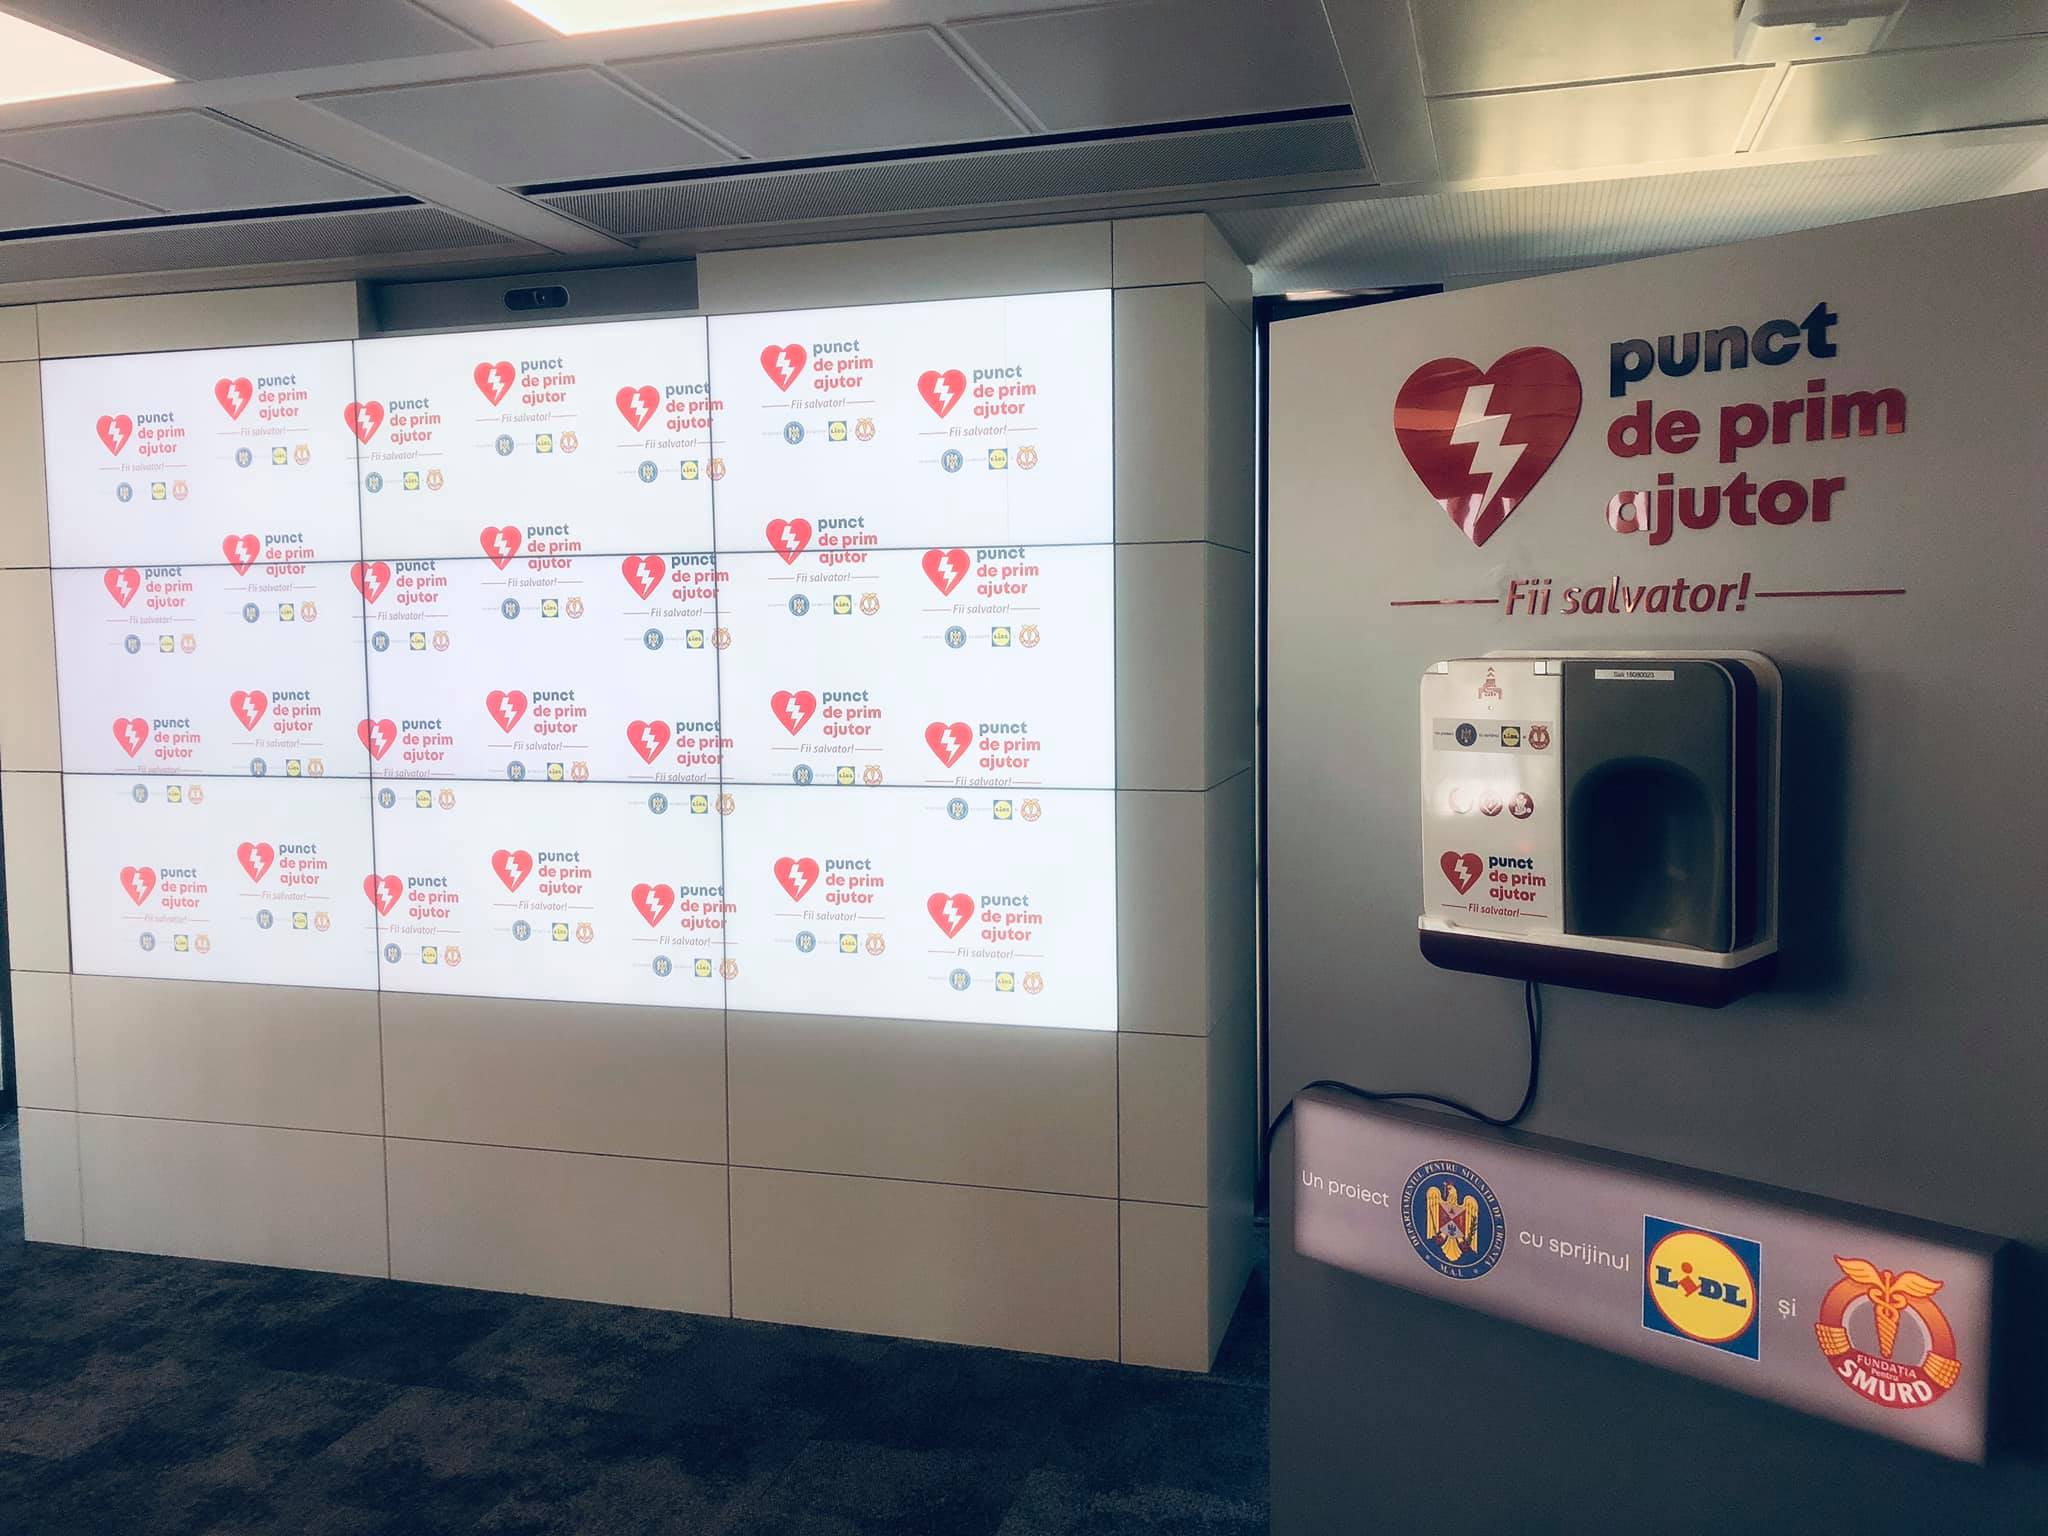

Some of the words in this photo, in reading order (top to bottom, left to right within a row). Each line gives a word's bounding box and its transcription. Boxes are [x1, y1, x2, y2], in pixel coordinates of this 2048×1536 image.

[813, 339, 860, 357] punct
[1610, 302, 1838, 397] punct
[520, 357, 564, 373] punct
[813, 358, 833, 371] de
[837, 356, 873, 373] prim
[257, 374, 297, 389] punct
[521, 374, 539, 387] de
[542, 372, 575, 389] prim
[973, 365, 1023, 383] punct
[665, 382, 711, 398] punct
[813, 374, 862, 391] ajutor
[258, 390, 274, 402] de
[277, 388, 307, 404] prim
[521, 390, 566, 405] ajutor
[973, 384, 994, 398] de
[998, 382, 1036, 400] prim
[258, 405, 299, 420] ajutor
[389, 397, 430, 413] punct
[666, 399, 685, 412] de
[688, 398, 723, 414] prim
[973, 401, 1025, 418] ajutor
[137, 411, 174, 426] punct
[389, 414, 406, 426] de
[409, 412, 441, 428] prim
[666, 415, 713, 431] ajutor
[1607, 401, 1700, 458] de
[1720, 378, 1907, 463] prim
[137, 427, 153, 439] de
[156, 425, 185, 441] prim
[389, 429, 432, 444] ajutor
[138, 441, 177, 456] ajutor
[1606, 472, 1845, 546] ajutor
[527, 523, 570, 540] punct
[818, 516, 865, 533] punct
[265, 532, 304, 547] punct
[527, 540, 545, 552] de
[548, 539, 581, 555] prim
[818, 533, 838, 546] de
[841, 532, 877, 549] prim
[265, 547, 281, 559] de
[284, 546, 314, 561] prim
[671, 552, 716, 569] punct
[818, 549, 867, 565] ajutor
[976, 546, 1026, 563] punct
[265, 562, 306, 576] ajutor
[395, 558, 436, 574] punct
[527, 555, 572, 571] ajutor
[976, 563, 997, 577] de
[1001, 562, 1038, 580] prim
[144, 564, 182, 580] punct
[671, 569, 690, 582] de
[694, 568, 728, 585] prim
[145, 580, 161, 592] de
[164, 579, 192, 594] prim
[396, 574, 413, 587] de
[416, 573, 447, 589] prim
[976, 580, 1027, 597] ajutor
[396, 590, 438, 605] ajutor
[672, 585, 719, 601] ajutor
[1506, 579, 1552, 615] Fii
[1561, 573, 1751, 614] salvator!
[146, 595, 185, 610] ajutor
[272, 689, 310, 705] punct
[532, 689, 575, 705] punct
[822, 690, 869, 706] punct
[272, 704, 289, 716] de
[291, 704, 321, 718] prim
[533, 704, 551, 717] de
[554, 704, 586, 720] prim
[822, 705, 842, 718] de
[846, 705, 881, 721] prim
[153, 718, 190, 732] punct
[273, 718, 313, 733] ajutor
[402, 719, 442, 734] punct
[533, 720, 577, 735] ajutor
[676, 720, 721, 736] punct
[822, 721, 871, 737] ajutor
[979, 722, 1028, 739] punct
[153, 731, 169, 742] de
[172, 731, 200, 745] prim
[402, 733, 419, 745] de
[422, 733, 453, 748] prim
[676, 735, 695, 748] de
[698, 735, 733, 750] prim
[979, 737, 999, 751] de
[1003, 738, 1040, 754] prim
[154, 745, 193, 758] ajutor
[402, 747, 444, 762] ajutor
[676, 750, 723, 765] ajutor
[979, 754, 1029, 770] ajutor
[279, 843, 317, 858] punct
[279, 856, 295, 868] de
[298, 857, 327, 871] prim
[538, 851, 580, 867] punct
[825, 858, 871, 875] punct
[1489, 856, 1533, 869] punct
[160, 867, 197, 882] punct
[279, 871, 319, 885] ajutor
[538, 865, 556, 877] de
[559, 866, 591, 880] prim
[1489, 870, 1508, 882] de
[1512, 872, 1546, 886] prim
[161, 880, 176, 892] de
[179, 881, 207, 895] prim
[408, 876, 448, 891] punct
[538, 880, 582, 895] ajutor
[825, 873, 845, 886] de
[848, 874, 884, 889] prim
[408, 889, 425, 902] de
[428, 890, 459, 905] prim
[680, 885, 725, 901] punct
[825, 889, 873, 905] ajutor
[1489, 886, 1536, 902] ajutor
[161, 895, 199, 908] ajutor
[680, 899, 699, 912] de
[702, 900, 736, 915] prim
[981, 894, 1029, 912] punct
[408, 904, 450, 919] ajutor
[981, 909, 1001, 923] de
[1005, 910, 1042, 926] prim
[1468, 903, 1479, 913] Fii
[1480, 905, 1520, 917] salvator!
[680, 915, 727, 930] ajutor
[980, 926, 1031, 942] ajutor
[1425, 1162, 1457, 1175] PENTRU
[1302, 1170, 1323, 1190] Un
[1328, 1180, 1389, 1208] proiect
[1519, 1231, 1543, 1248] cu
[1549, 1239, 1630, 1272] sprijinul
[1838, 1359, 1933, 1404] SMURD
[1871, 1367, 1899, 1382] Pentru
